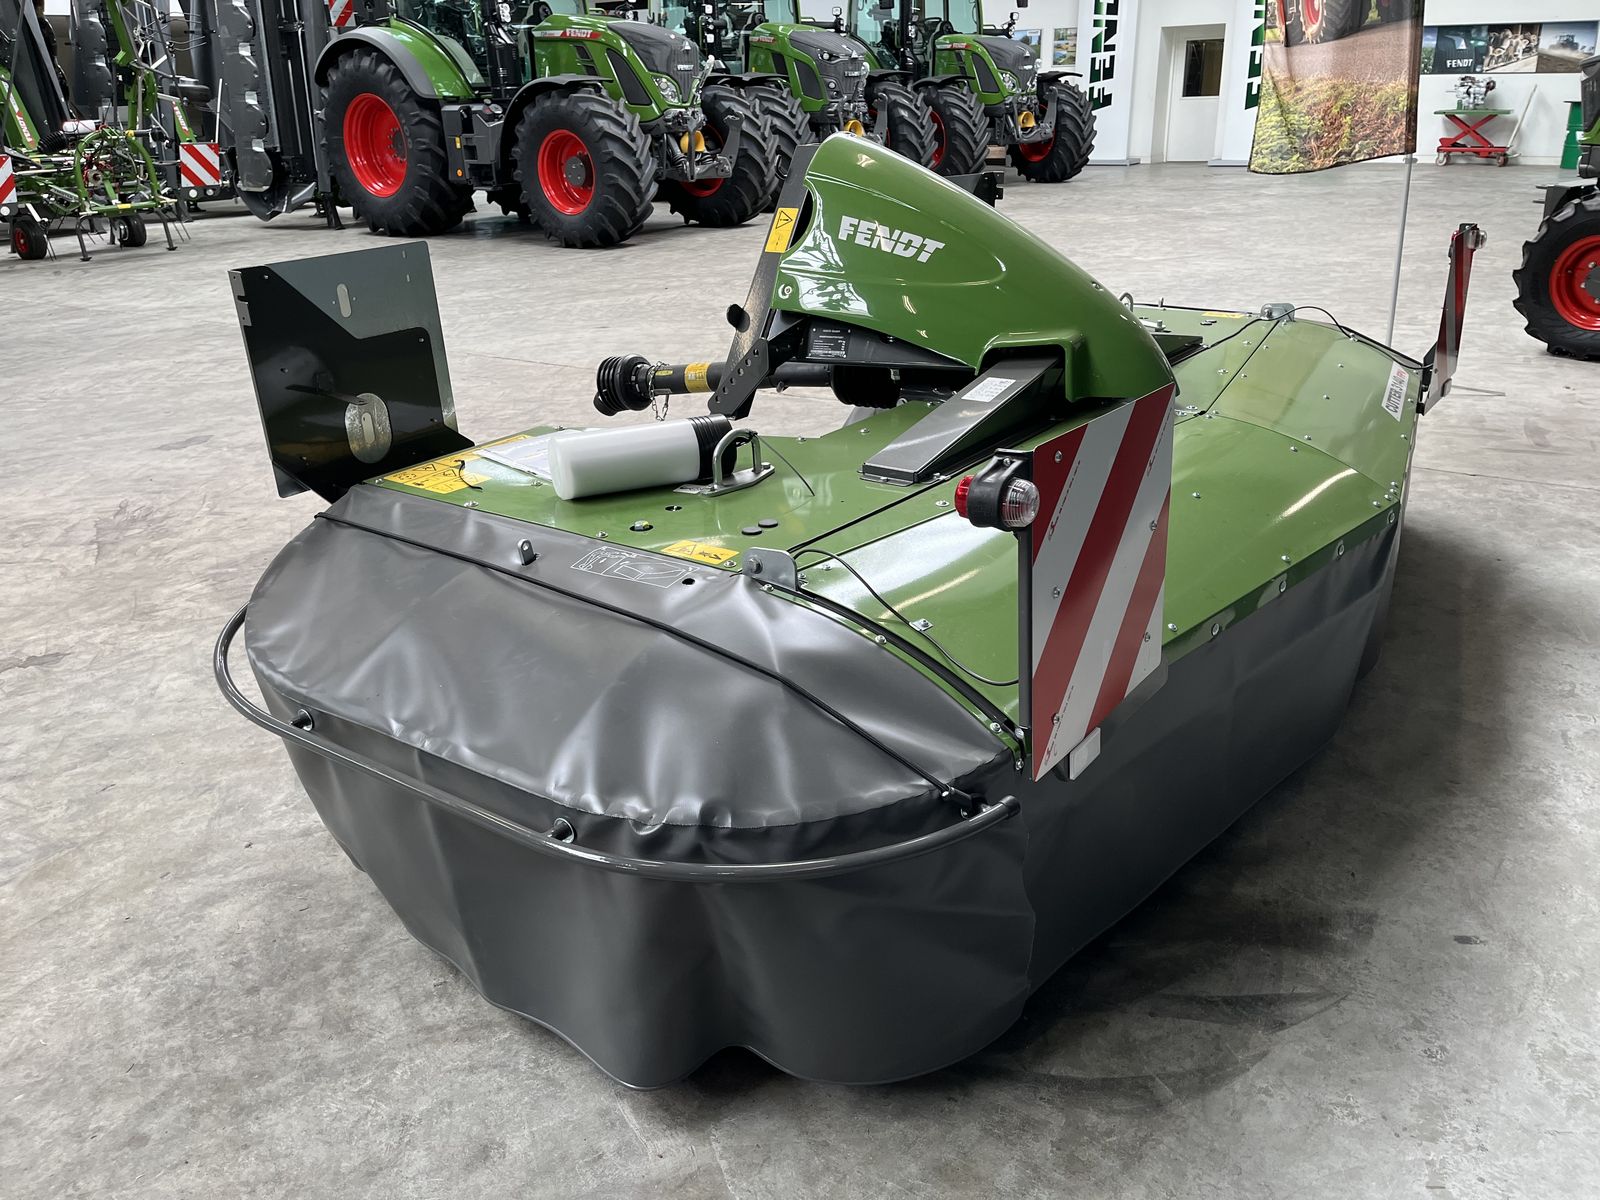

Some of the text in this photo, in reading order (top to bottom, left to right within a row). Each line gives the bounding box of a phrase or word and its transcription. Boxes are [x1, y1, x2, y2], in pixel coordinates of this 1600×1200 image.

[565, 28, 593, 38] FENDT
[1446, 58, 1474, 69] FENDT
[838, 215, 946, 264] FENDT
[1385, 387, 1402, 413] CUTTER
